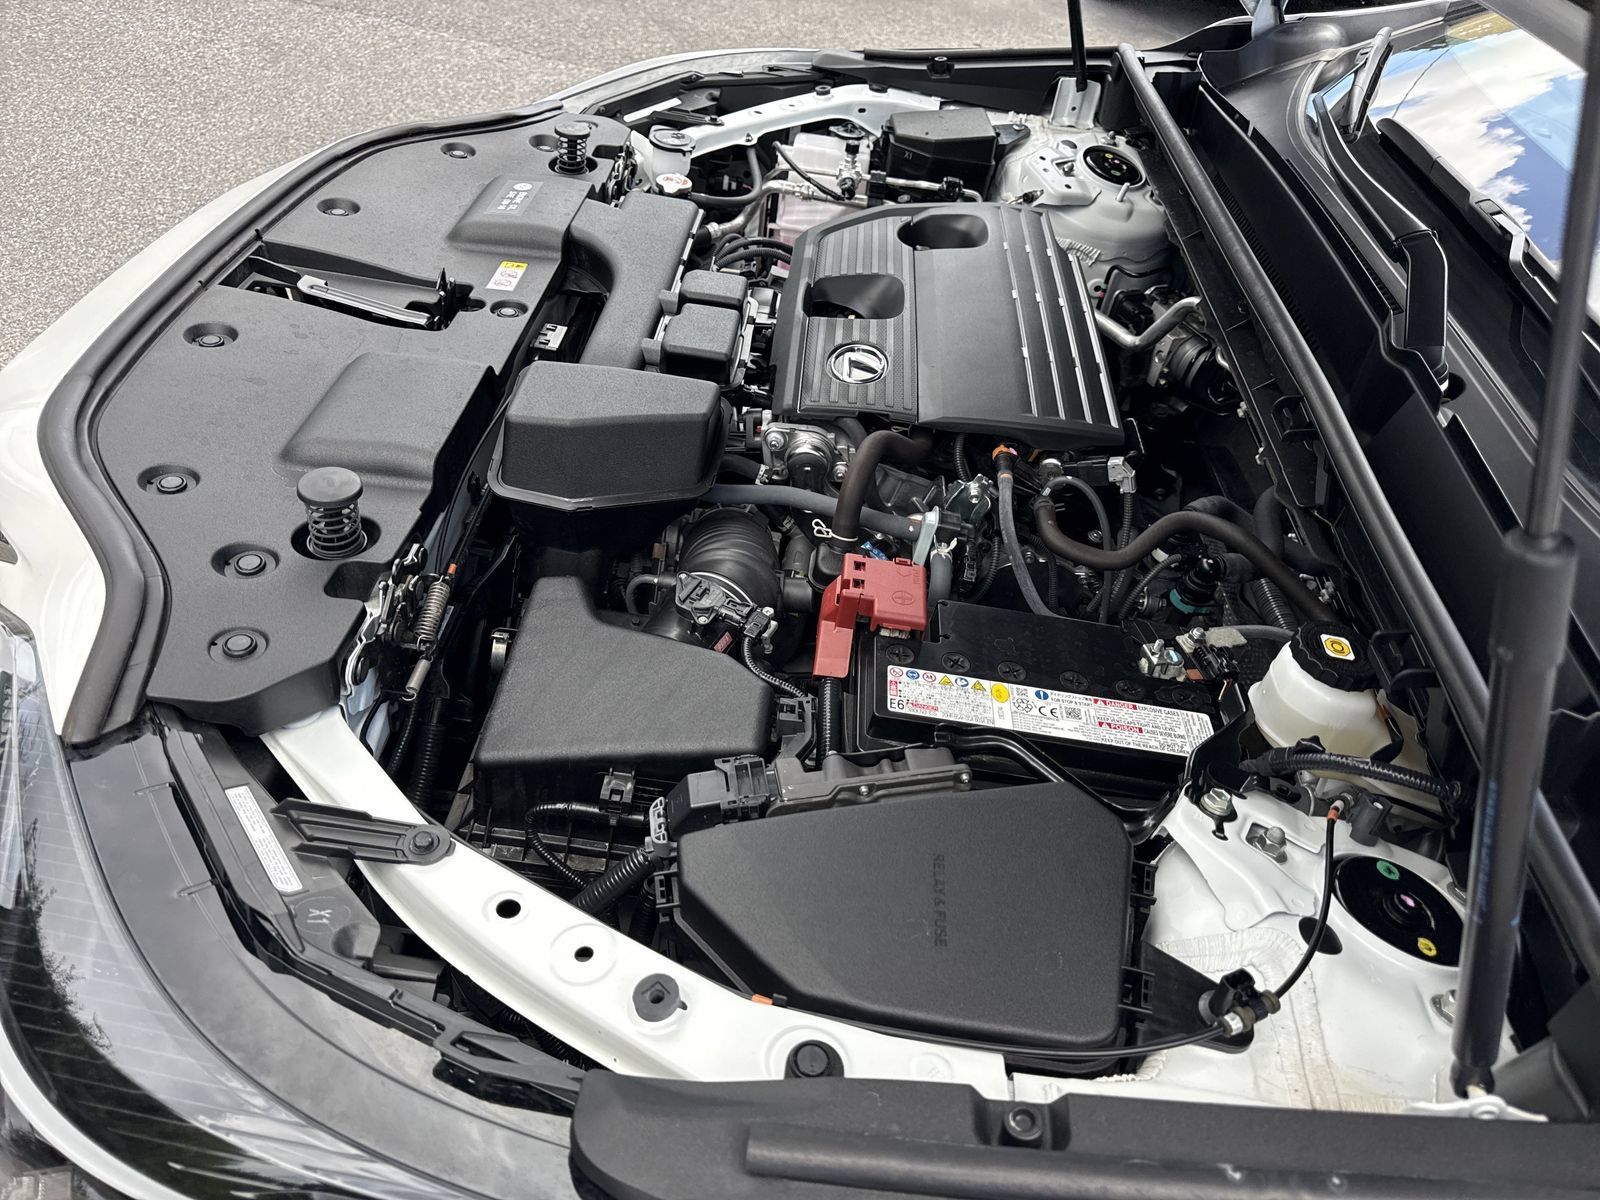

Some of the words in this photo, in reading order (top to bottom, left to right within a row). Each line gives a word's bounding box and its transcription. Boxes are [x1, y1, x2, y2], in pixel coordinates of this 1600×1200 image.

[889, 698, 905, 710] E6
[1107, 700, 1134, 709] DANGER
[1138, 705, 1163, 714] EXPLOSIVE
[1163, 709, 1180, 717] GASES
[1111, 723, 1138, 732] POISON
[933, 853, 946, 896] RELAY
[934, 909, 948, 948] FUSE
